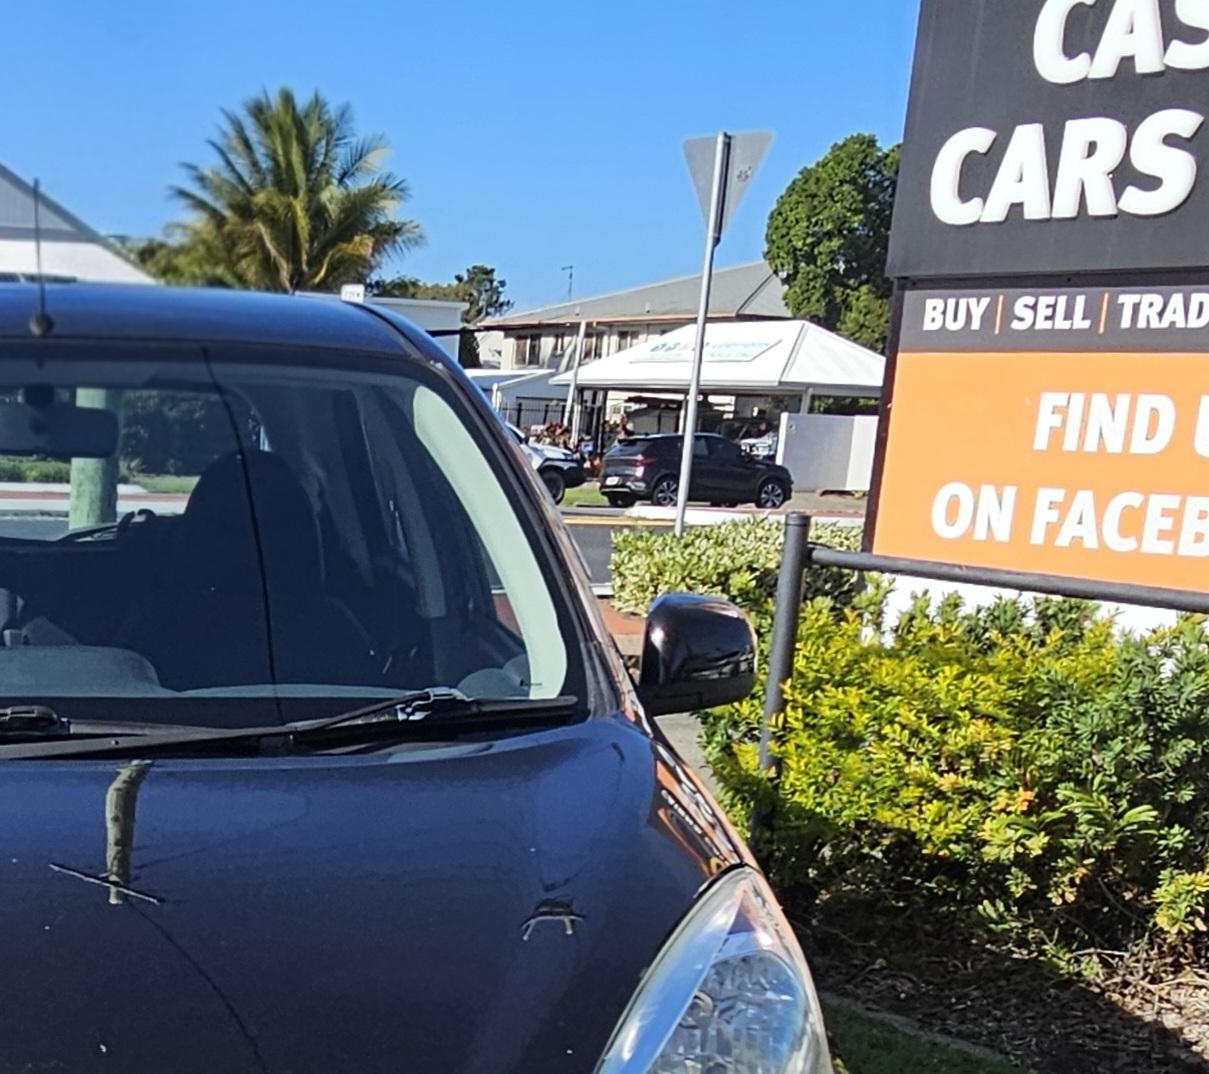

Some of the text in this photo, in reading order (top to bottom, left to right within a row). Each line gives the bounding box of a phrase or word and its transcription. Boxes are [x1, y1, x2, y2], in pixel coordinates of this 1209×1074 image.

[930, 108, 1205, 226] CARS
[922, 293, 1209, 331] BUY SELL TRAD
[1033, 391, 1176, 454] FIND
[930, 481, 1018, 543] ON
